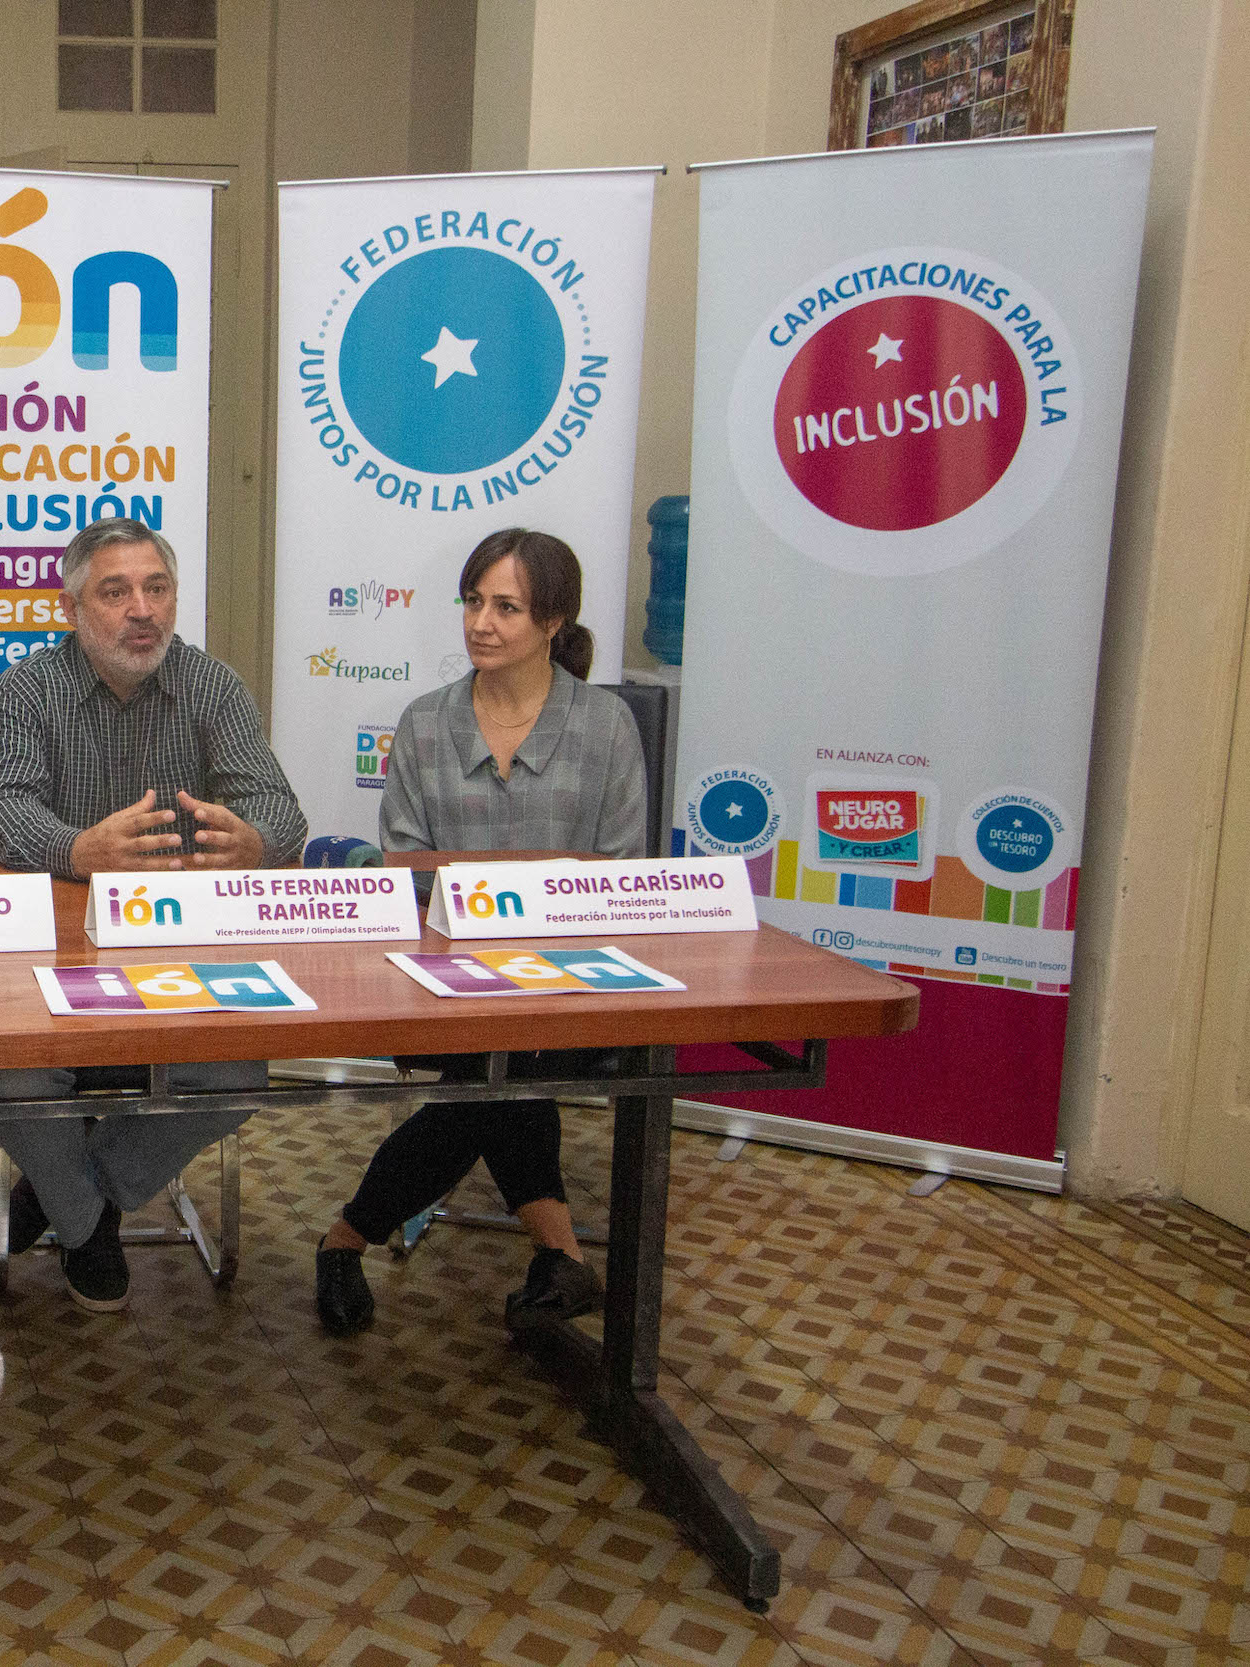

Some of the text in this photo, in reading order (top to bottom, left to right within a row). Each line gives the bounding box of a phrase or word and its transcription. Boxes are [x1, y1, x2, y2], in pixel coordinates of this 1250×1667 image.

[340, 210, 585, 292] FEDERACIÓN
[769, 262, 1067, 426] CAPACITACIONES PARA LA
[793, 374, 999, 454] INCLUSIÓN
[299, 341, 609, 511] JUNTOS POR LA INCLUSIÓN
[335, 659, 411, 683] fupacel
[816, 749, 930, 768] EN ALIANZA CON:
[357, 779, 385, 788] PARAGU
[701, 770, 774, 797] FEDERACIÓN
[828, 800, 901, 816] NEURO
[1032, 801, 1065, 833] CUENTOS
[688, 802, 706, 840] JUNTOS
[704, 837, 725, 853] POR
[728, 845, 741, 854] LA
[833, 815, 905, 830] JUGAR
[990, 829, 1043, 845] DESCUBRO
[839, 842, 905, 858] Y CREAR
[1000, 843, 1037, 857] TESORO
[214, 875, 394, 897] LUÍS FERNANDO
[543, 869, 725, 896] SONIA CARÍSIMO
[108, 885, 183, 927] ión
[258, 898, 359, 921] RAMÍREZ
[450, 880, 525, 919] ión
[607, 897, 667, 908] Presidenta
[545, 907, 732, 923] Federación Juntos por la Inclusión
[215, 927, 280, 937] Vice-Presidente
[281, 927, 305, 936] AIEPP
[311, 925, 356, 937] Olimpiadas
[358, 924, 400, 935] Especiales
[982, 952, 1023, 966] Descubro
[1025, 960, 1037, 969] un
[1039, 961, 1067, 972] tesoro
[94, 970, 277, 997] ión
